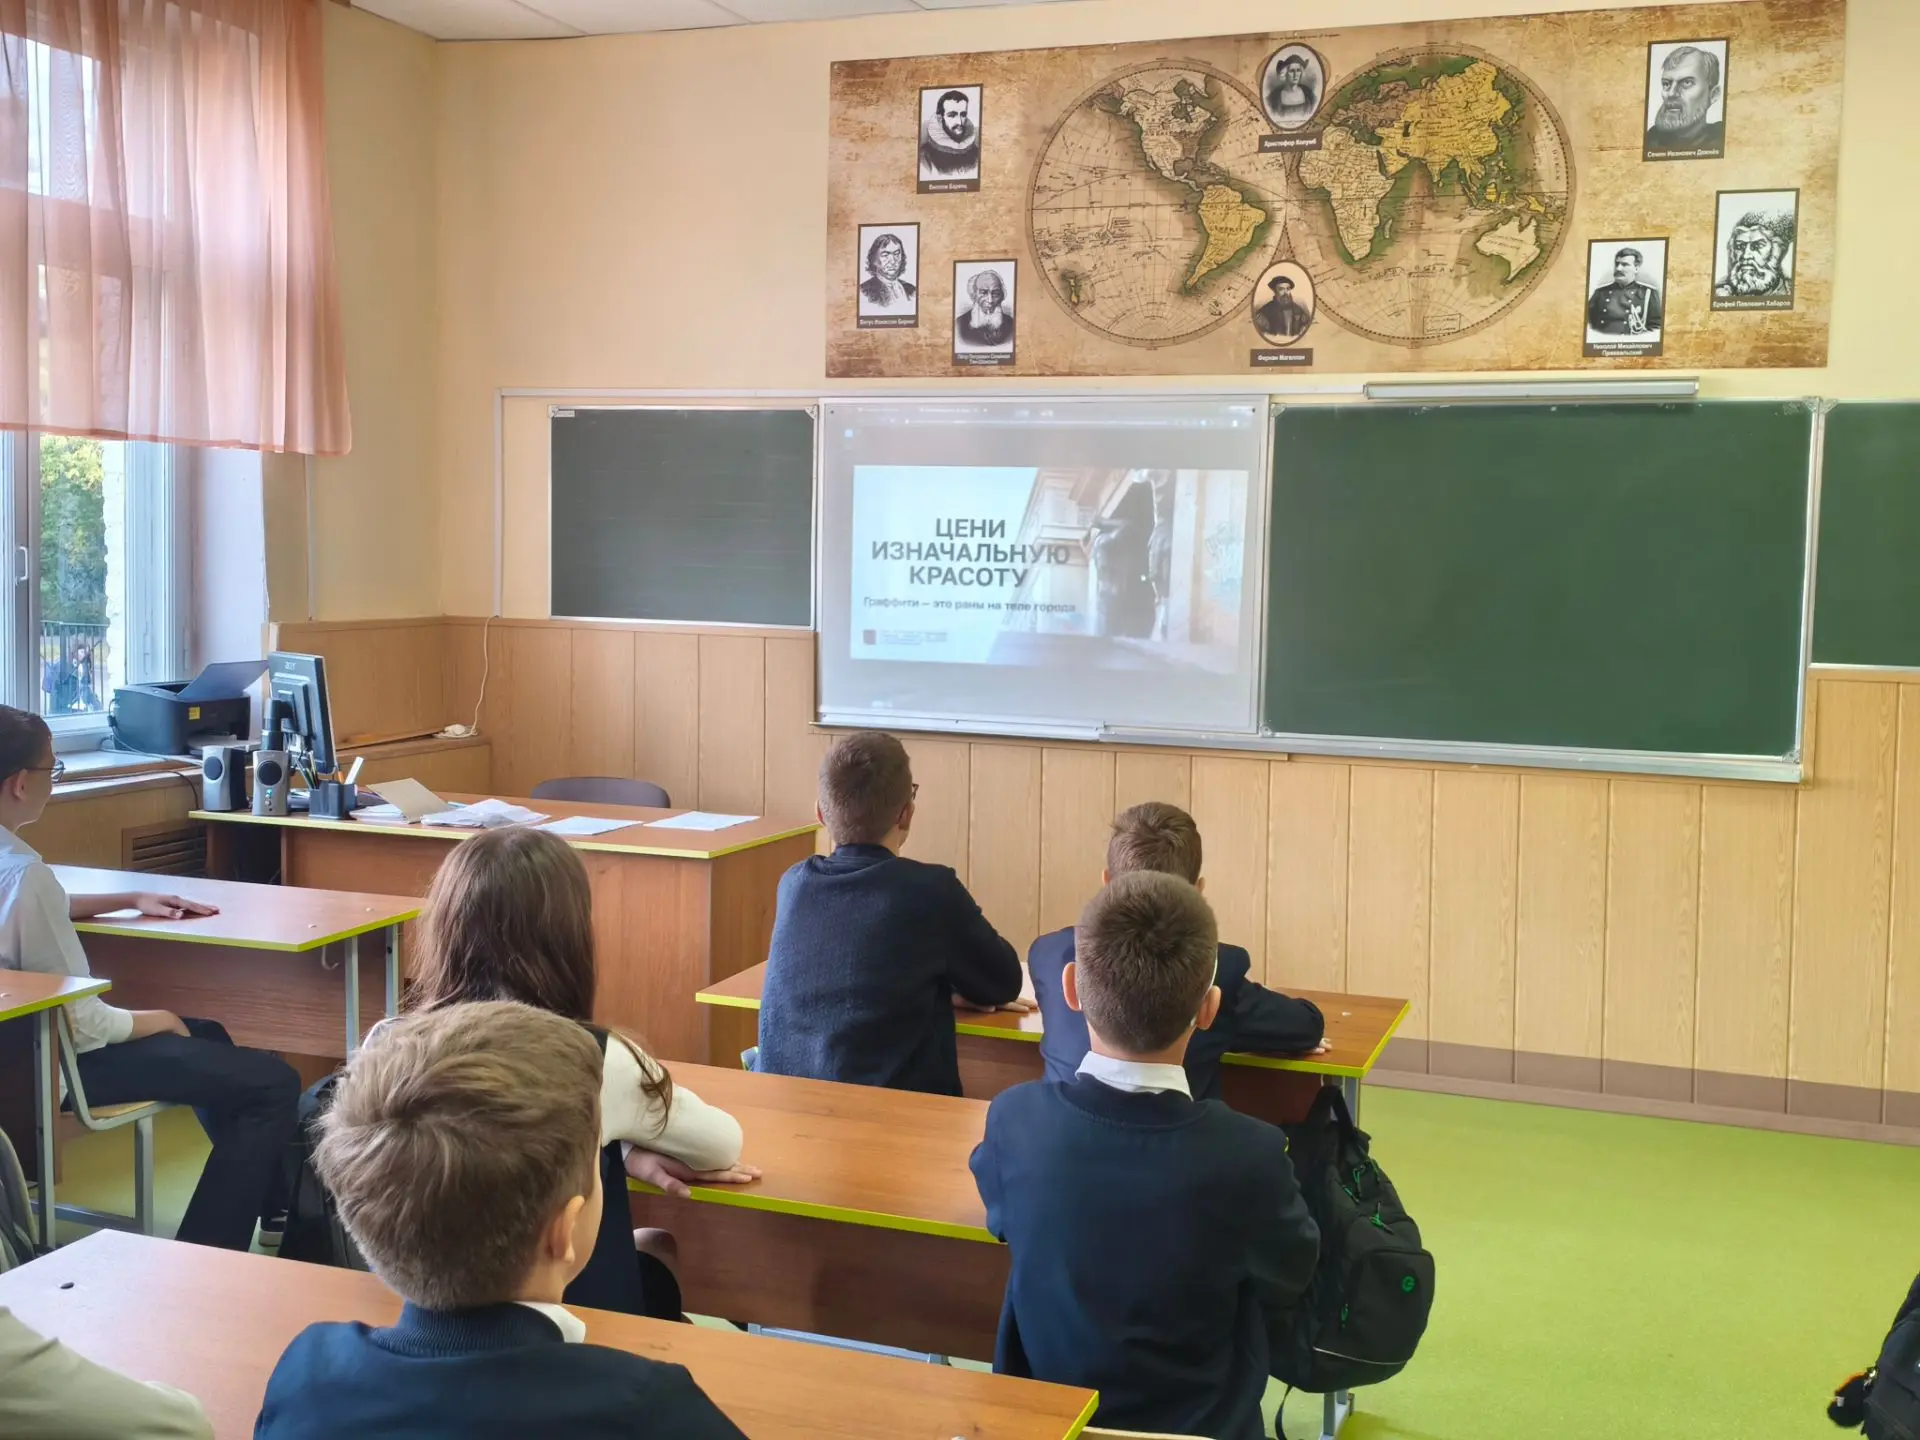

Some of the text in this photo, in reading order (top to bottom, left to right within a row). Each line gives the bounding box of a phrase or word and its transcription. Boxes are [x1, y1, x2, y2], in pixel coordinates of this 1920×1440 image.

[935, 518, 1006, 540] ЦЕНИ
[872, 541, 1071, 564] ИЗНАЧАЛЬНУЮ
[909, 566, 1028, 588] КРАСОТУ
[863, 597, 919, 609] Граффити
[933, 601, 952, 609] это
[955, 602, 984, 611] раны
[1034, 604, 1076, 614] города
